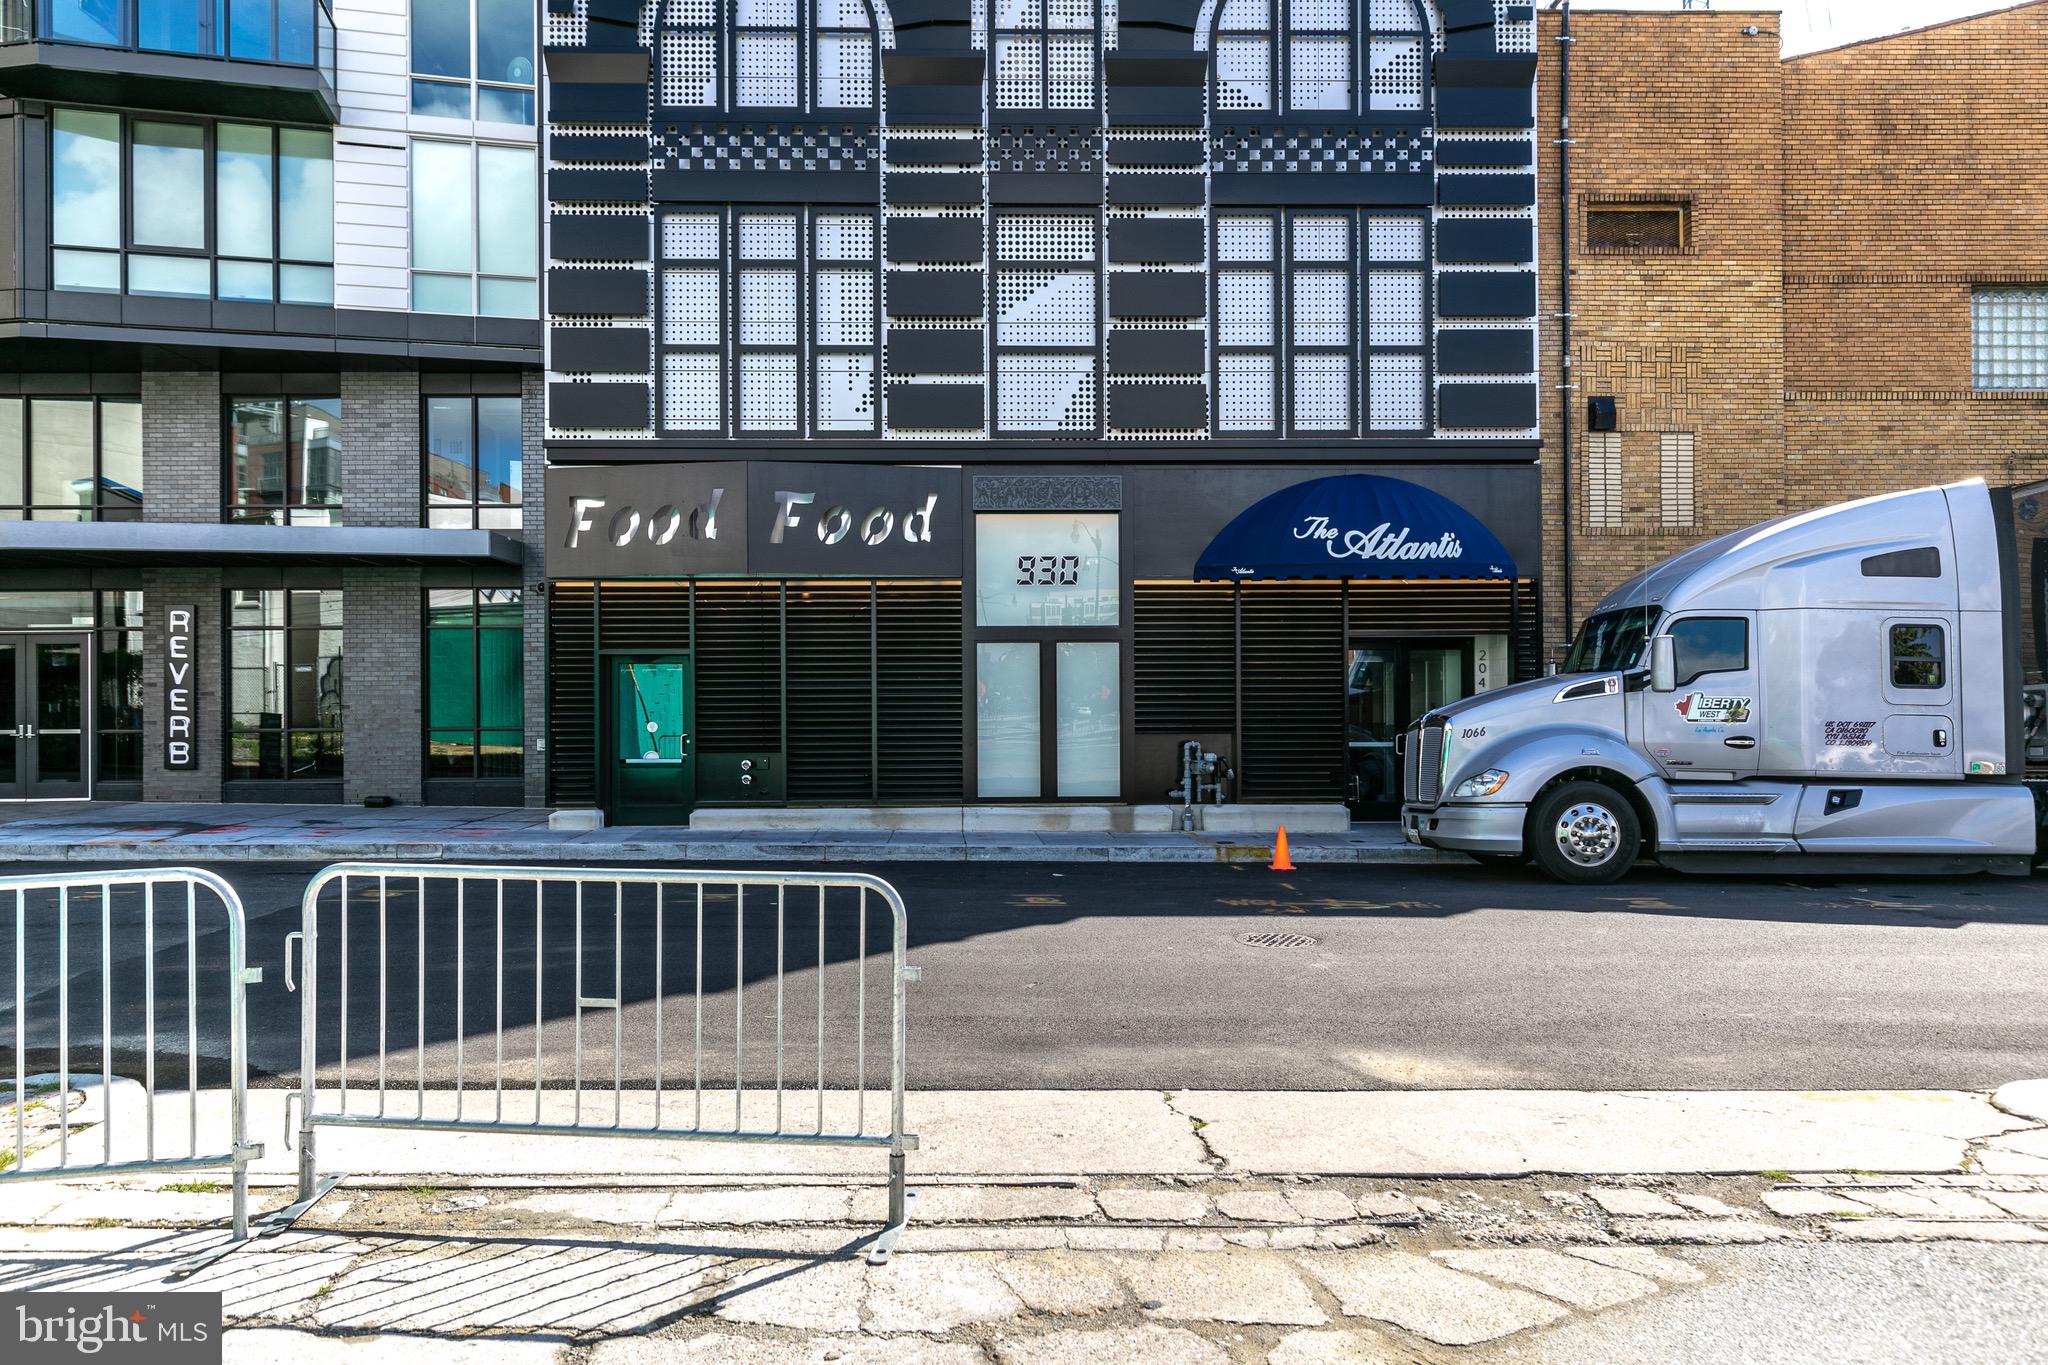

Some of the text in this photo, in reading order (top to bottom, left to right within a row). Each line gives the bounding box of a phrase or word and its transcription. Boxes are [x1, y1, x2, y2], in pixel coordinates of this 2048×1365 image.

[564, 488, 724, 548] Food
[769, 491, 938, 545] Food
[1293, 516, 1463, 560] The Atlantis
[1016, 555, 1079, 585] 930
[168, 610, 191, 765] REVERB
[1687, 691, 1751, 720] LIBERTY
[1461, 726, 1486, 739] 1066
[1698, 710, 1721, 719] WEST
